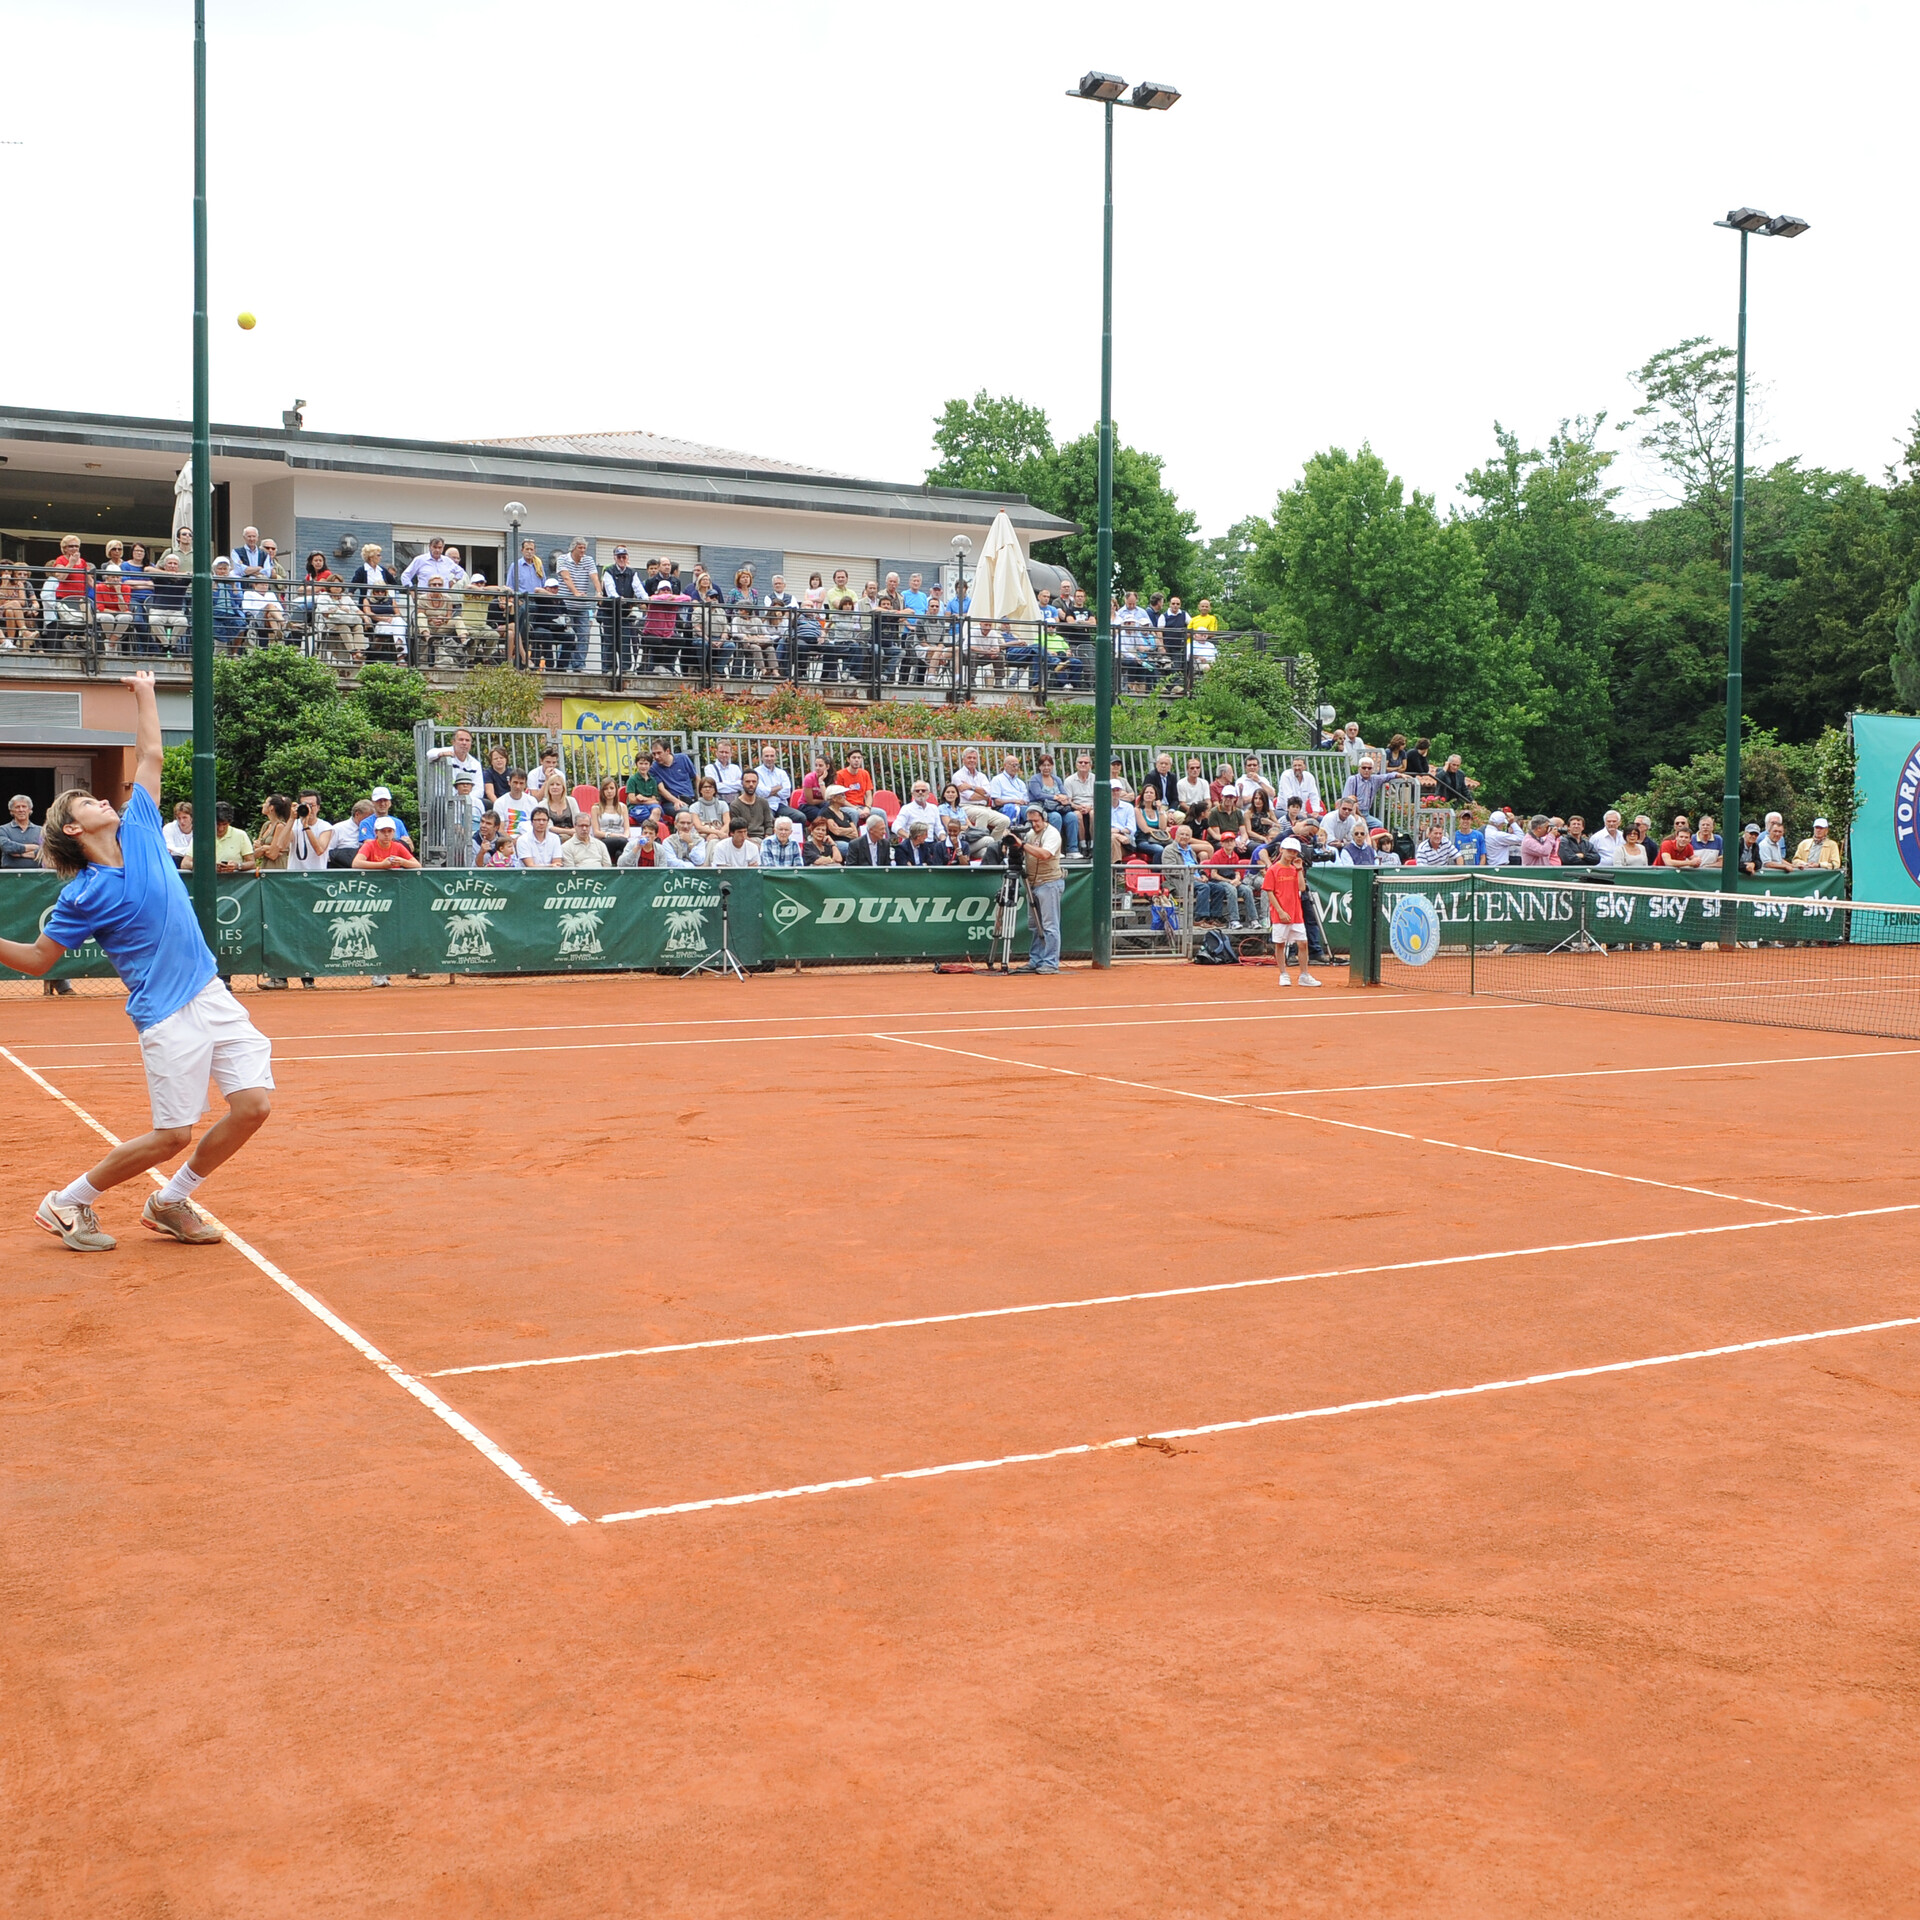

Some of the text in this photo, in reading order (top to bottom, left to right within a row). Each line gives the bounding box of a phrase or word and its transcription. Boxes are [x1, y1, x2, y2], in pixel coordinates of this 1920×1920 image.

[313, 899, 393, 913] OTTOLINA
[431, 897, 508, 911] OTTOLINA
[543, 896, 617, 910] OTTOLINA
[652, 895, 721, 908] OTTOLINA
[1596, 890, 1636, 924] sky
[1649, 892, 1689, 924] sky
[1753, 890, 1790, 923] sky
[1803, 890, 1838, 922] sky
